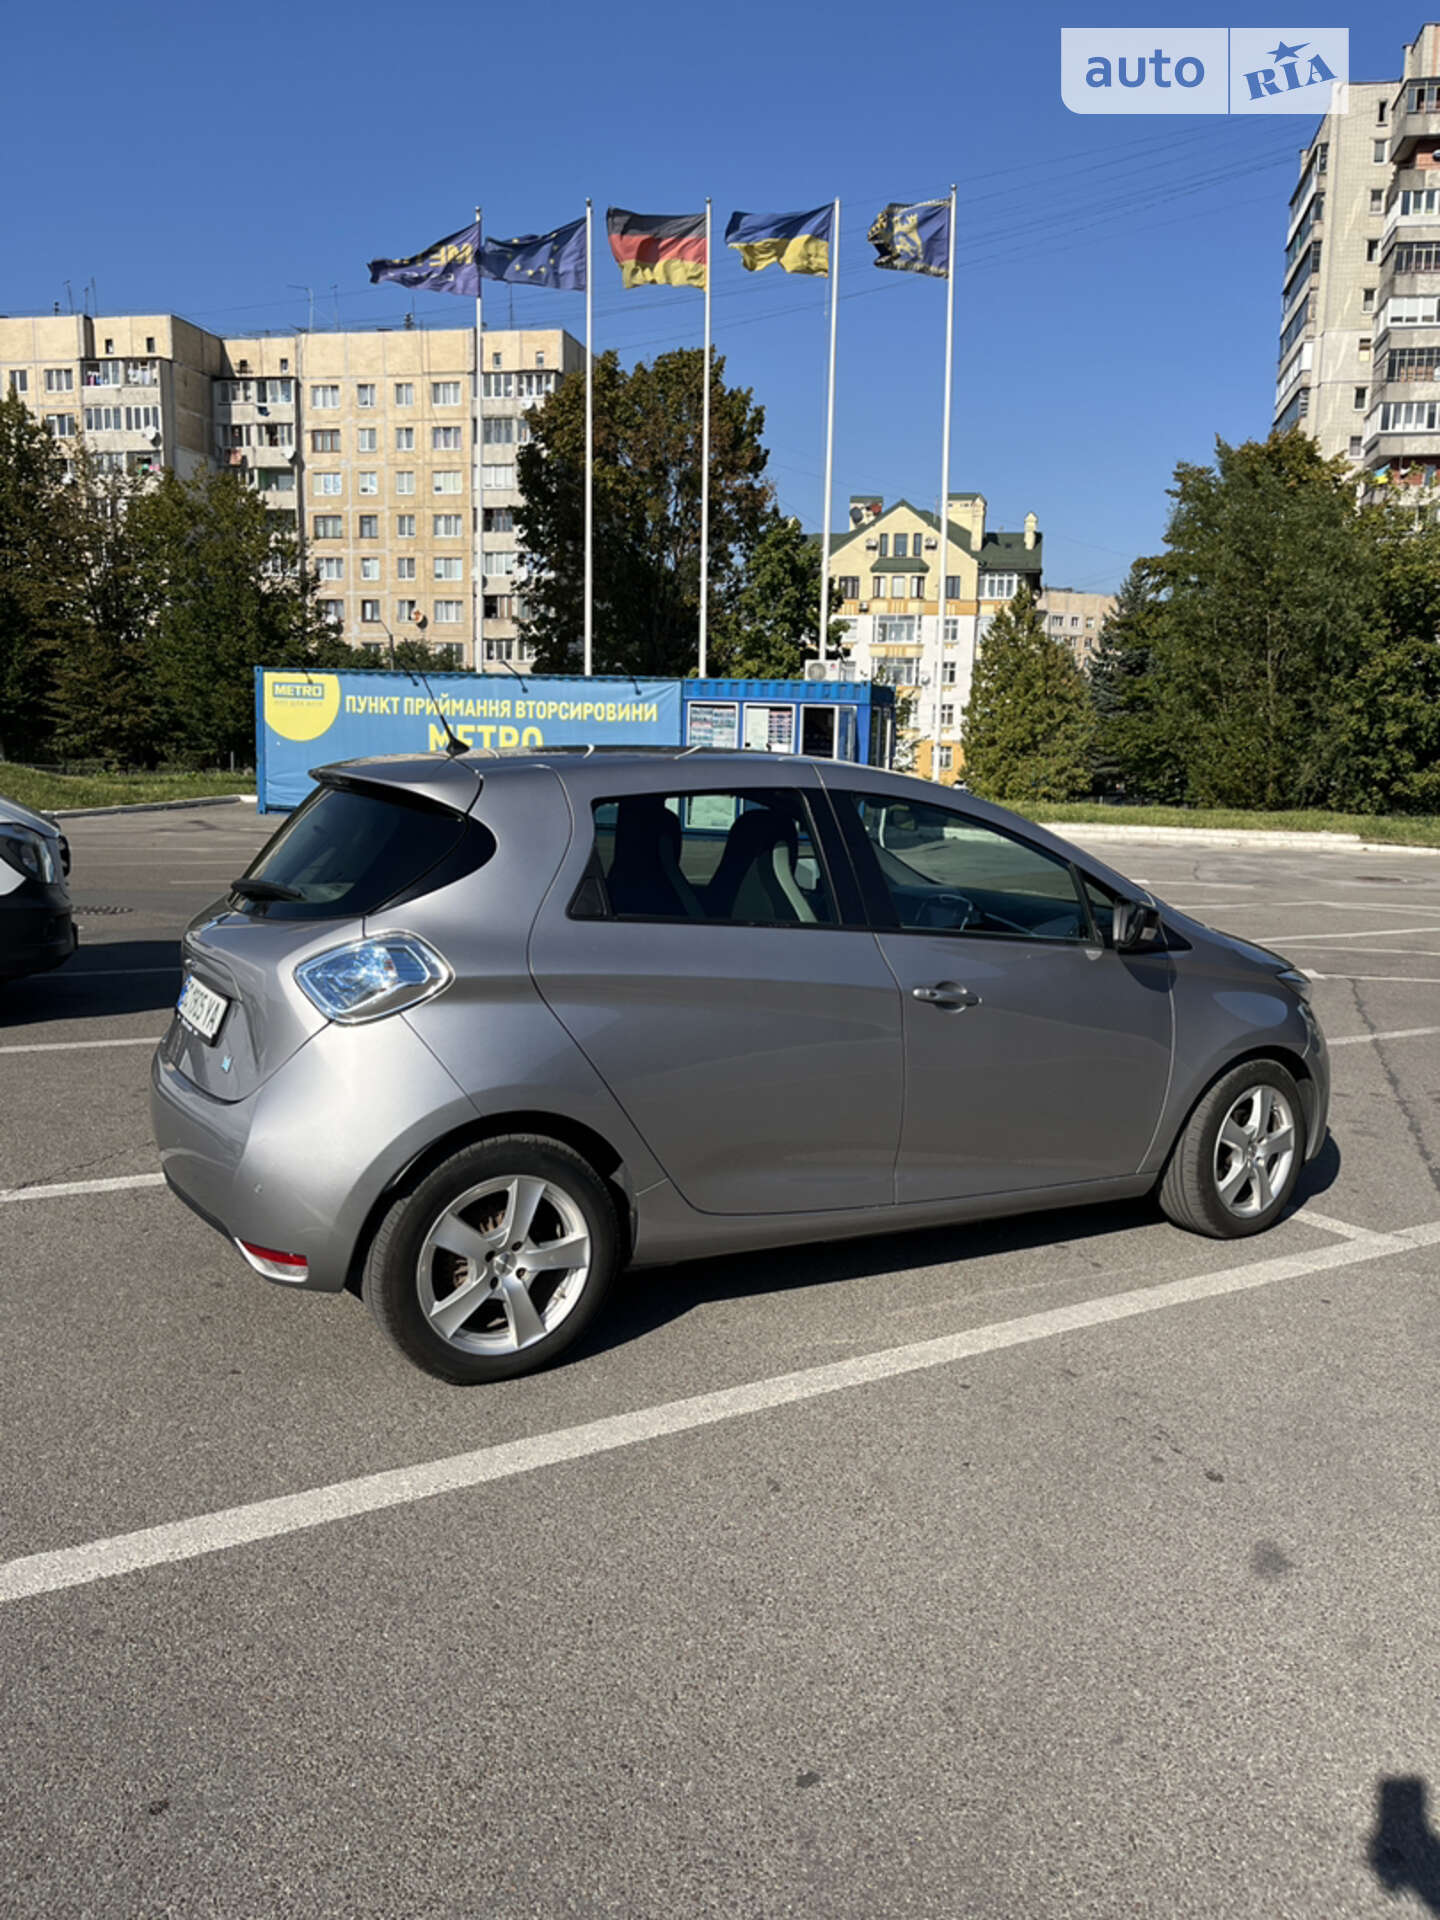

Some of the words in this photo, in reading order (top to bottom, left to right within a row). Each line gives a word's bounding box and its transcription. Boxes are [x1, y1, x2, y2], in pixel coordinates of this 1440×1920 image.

[274, 684, 322, 698] METRO
[345, 695, 400, 715] ПУНКТ
[404, 693, 512, 718] ПРИЙМАННЯ
[515, 699, 659, 723] ВТОРСИРОВИНИ
